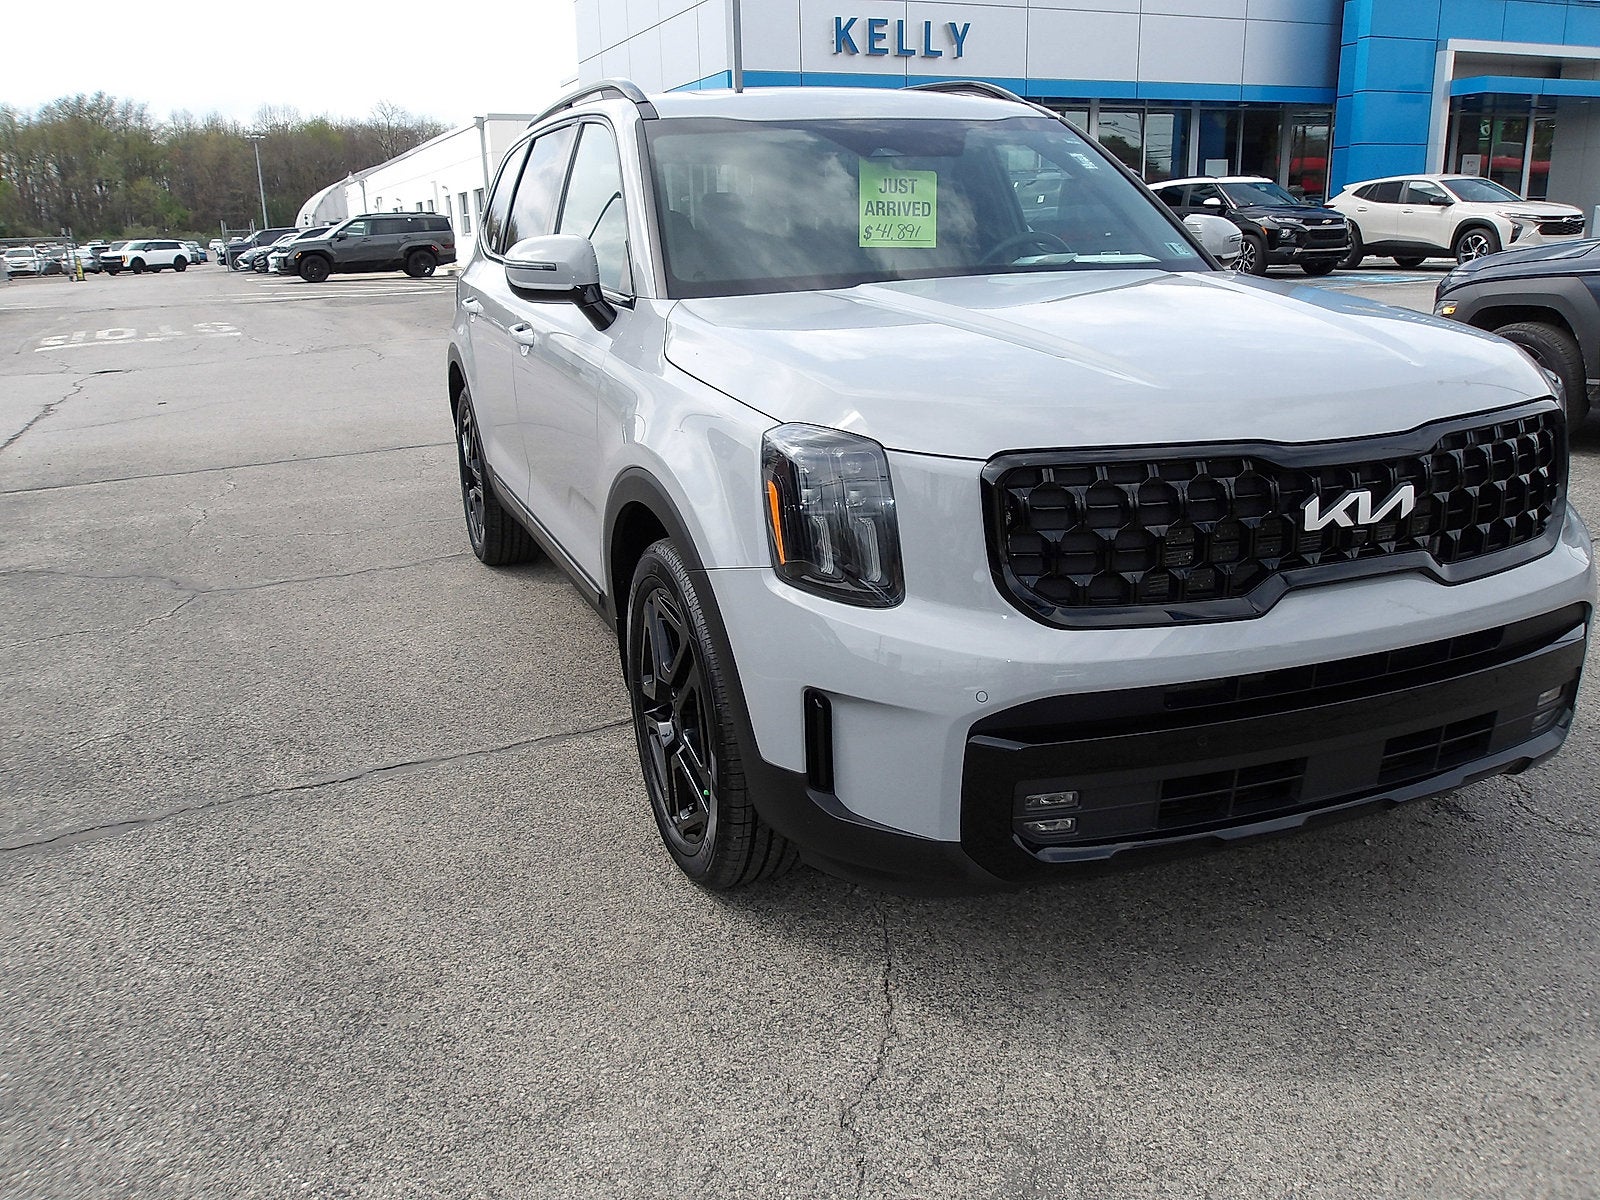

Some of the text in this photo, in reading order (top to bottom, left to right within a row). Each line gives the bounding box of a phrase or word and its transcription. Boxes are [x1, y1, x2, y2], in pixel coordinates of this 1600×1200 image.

[833, 16, 971, 59] KELLY
[878, 177, 917, 194] JUST
[864, 200, 931, 217] ARRIVED
[1303, 483, 1415, 532] KIA
